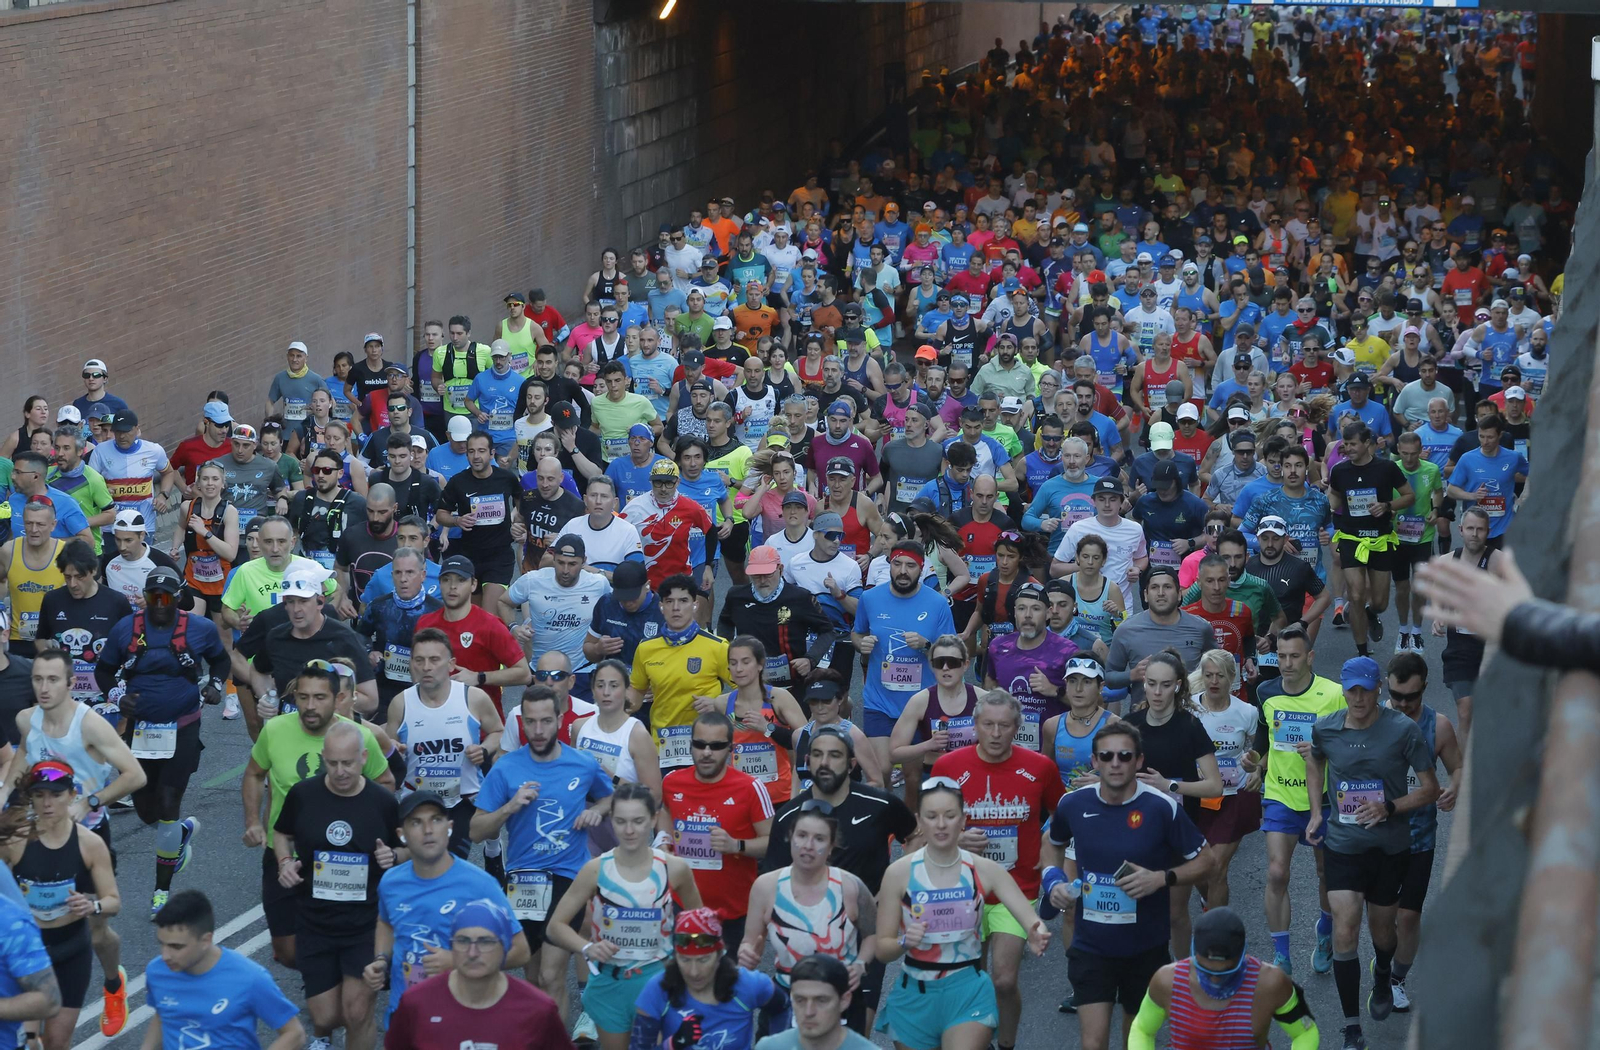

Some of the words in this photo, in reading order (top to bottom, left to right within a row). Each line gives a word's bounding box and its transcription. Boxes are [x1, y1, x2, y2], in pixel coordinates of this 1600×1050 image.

[476, 510, 501, 518] ARTURO
[530, 510, 557, 526] 1519
[122, 584, 139, 592] edp
[1085, 613, 1105, 621] POWER
[1018, 695, 1047, 704] Platform
[1288, 713, 1312, 721] ZURICH
[1285, 733, 1304, 742] 1976
[413, 738, 465, 756] AVIS
[591, 742, 616, 753] ZURICH
[745, 744, 770, 752] ZURICH
[742, 764, 768, 773] ALICIA
[1350, 782, 1378, 790] ZURICH
[678, 845, 716, 857] MANOLO
[332, 854, 363, 863] ZURICH
[331, 868, 350, 876] 10382
[314, 880, 333, 888] MANU
[932, 890, 966, 901] ZURICH
[1100, 891, 1117, 899] 5372
[516, 898, 538, 909] CABA
[1096, 900, 1121, 912] NICO
[621, 909, 655, 919] ZURICH
[932, 908, 954, 916] 10020
[602, 934, 658, 948] MAGDALENA
